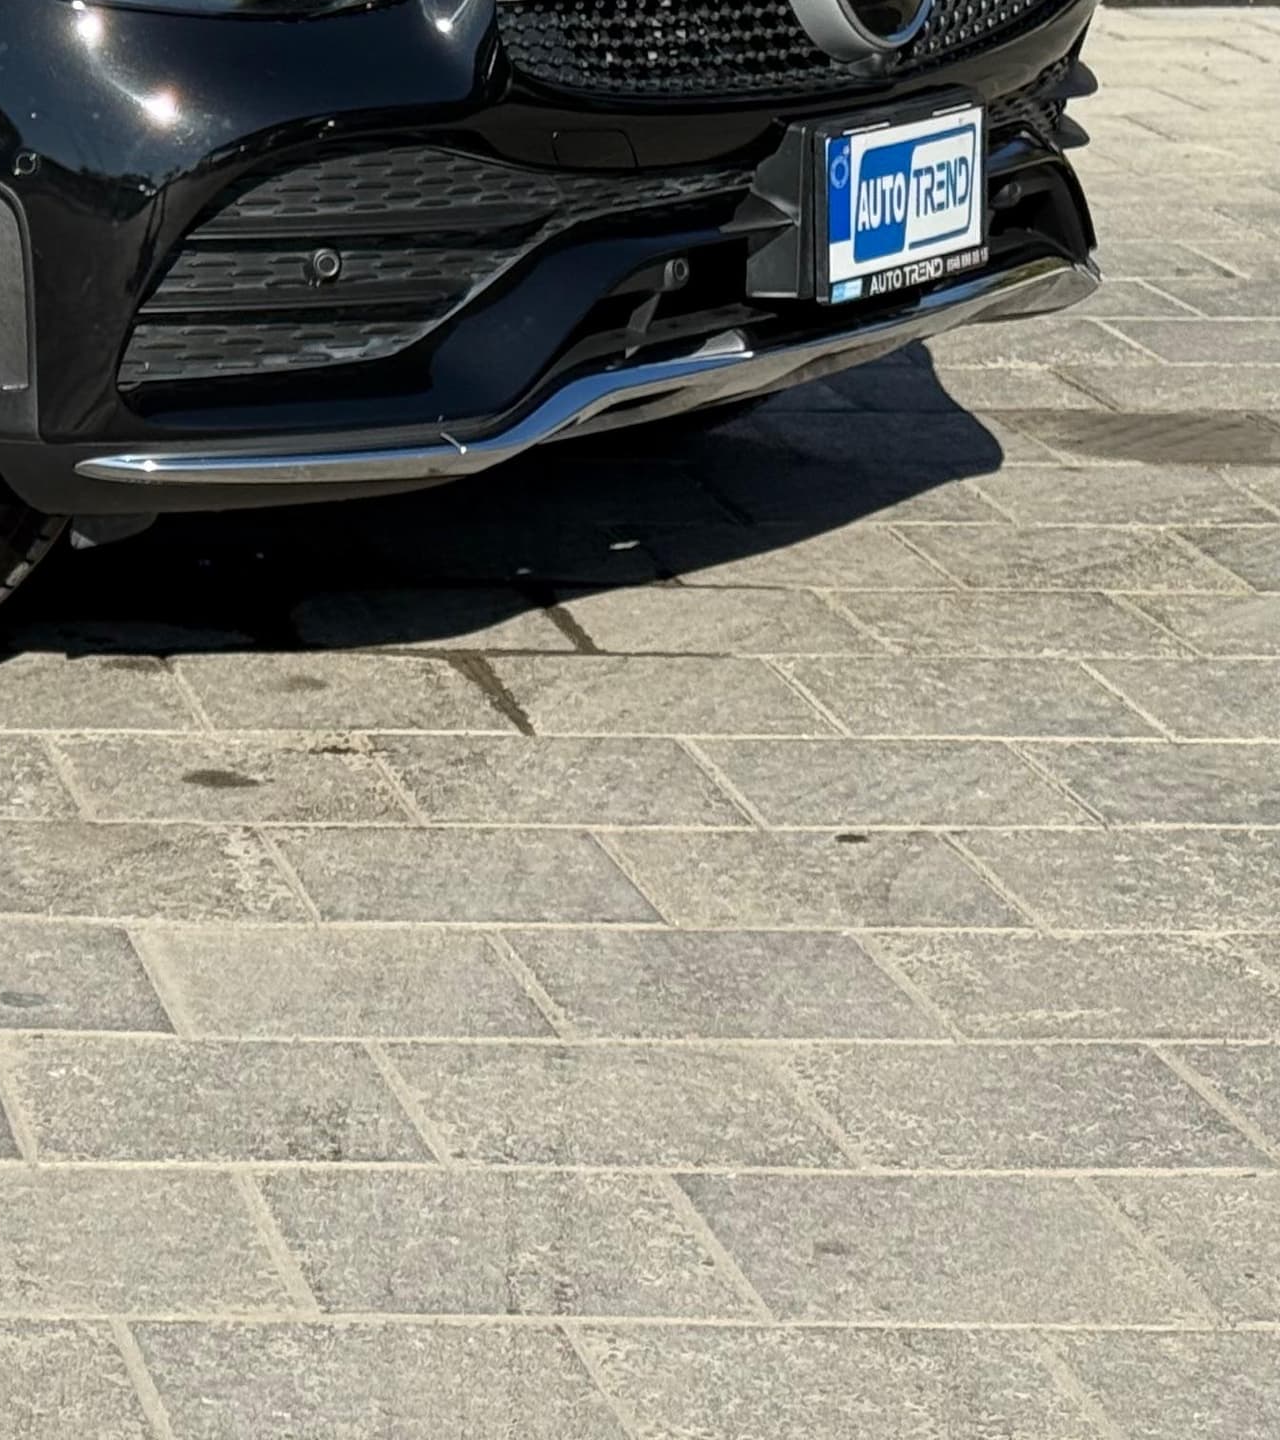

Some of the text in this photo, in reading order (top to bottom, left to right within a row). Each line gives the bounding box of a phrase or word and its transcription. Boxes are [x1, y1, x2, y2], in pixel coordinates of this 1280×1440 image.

[857, 155, 970, 232] AUTO TREND
[869, 270, 903, 296] AUTO
[903, 257, 943, 287] TREND
